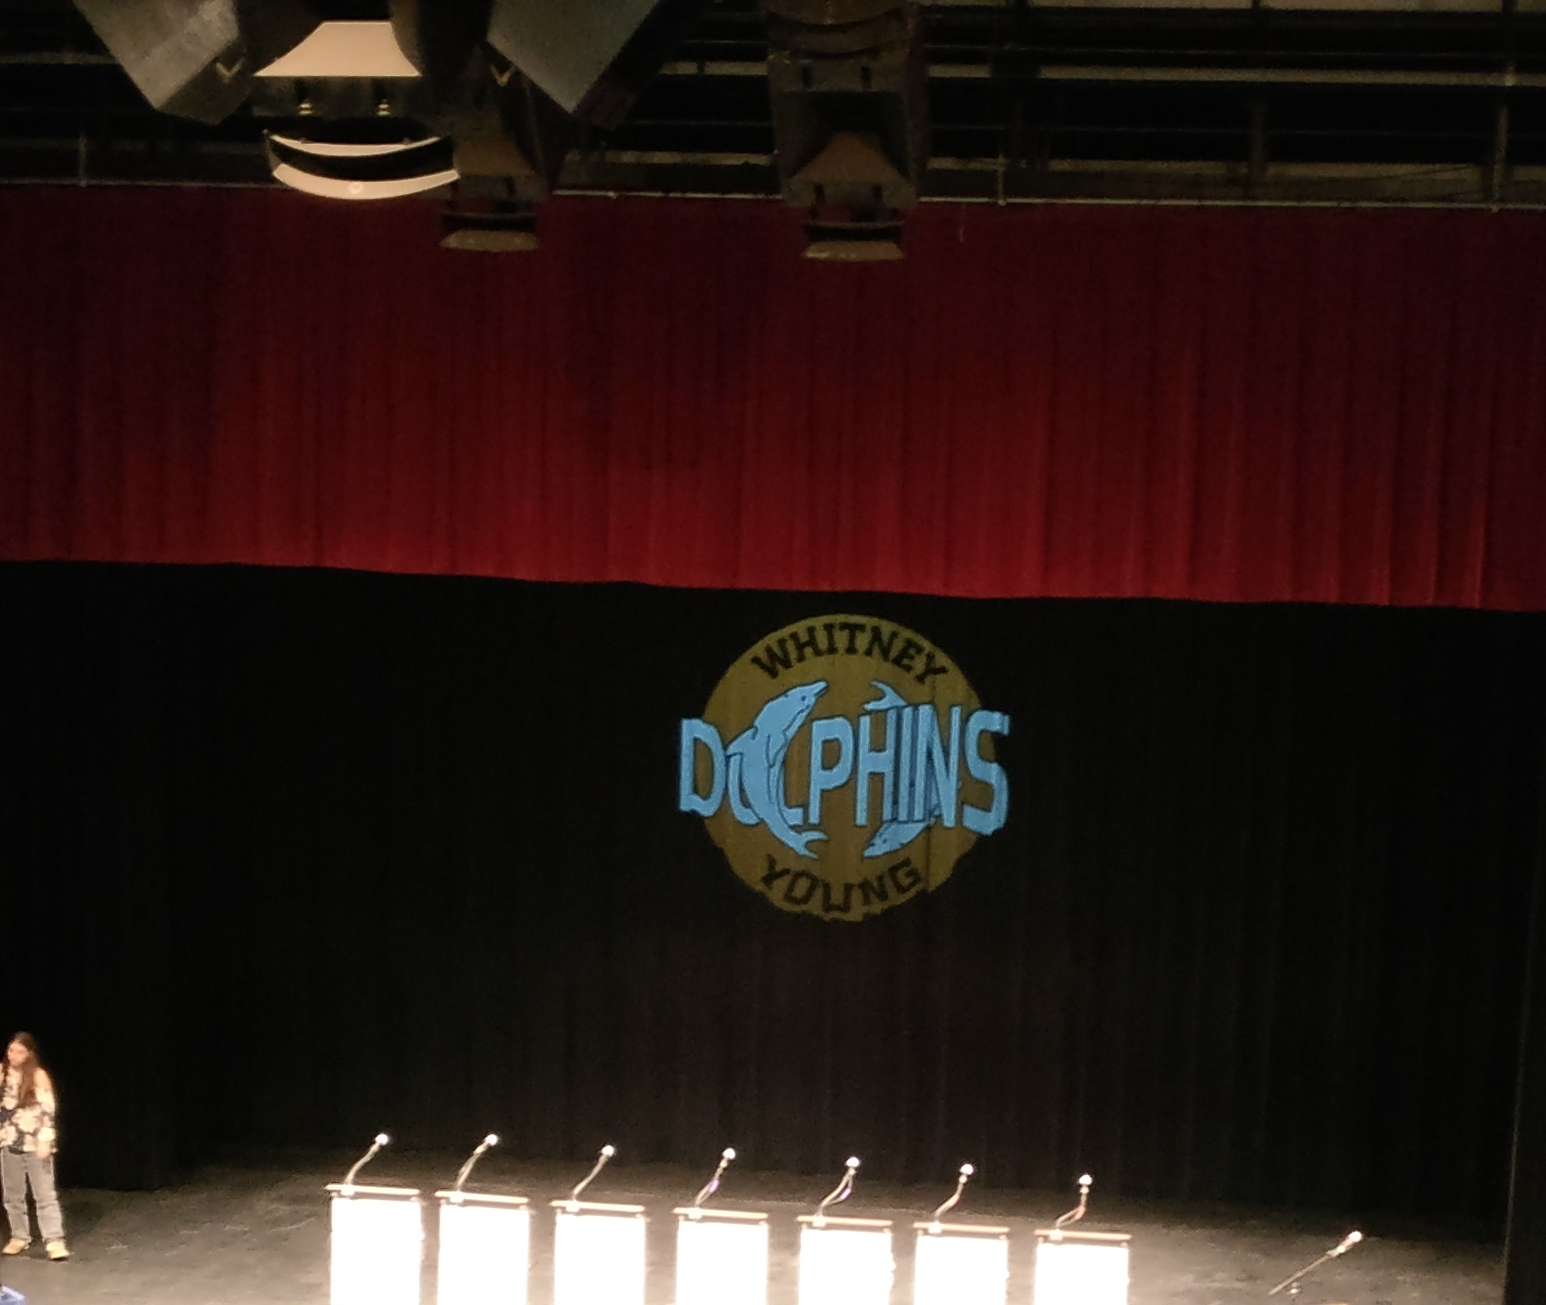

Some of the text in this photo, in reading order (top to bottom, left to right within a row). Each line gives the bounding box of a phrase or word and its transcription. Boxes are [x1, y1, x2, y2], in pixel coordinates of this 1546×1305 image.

[751, 621, 949, 684] WHITNEY
[679, 704, 1010, 836] DOLPHINS
[760, 853, 921, 913] YOUNG
